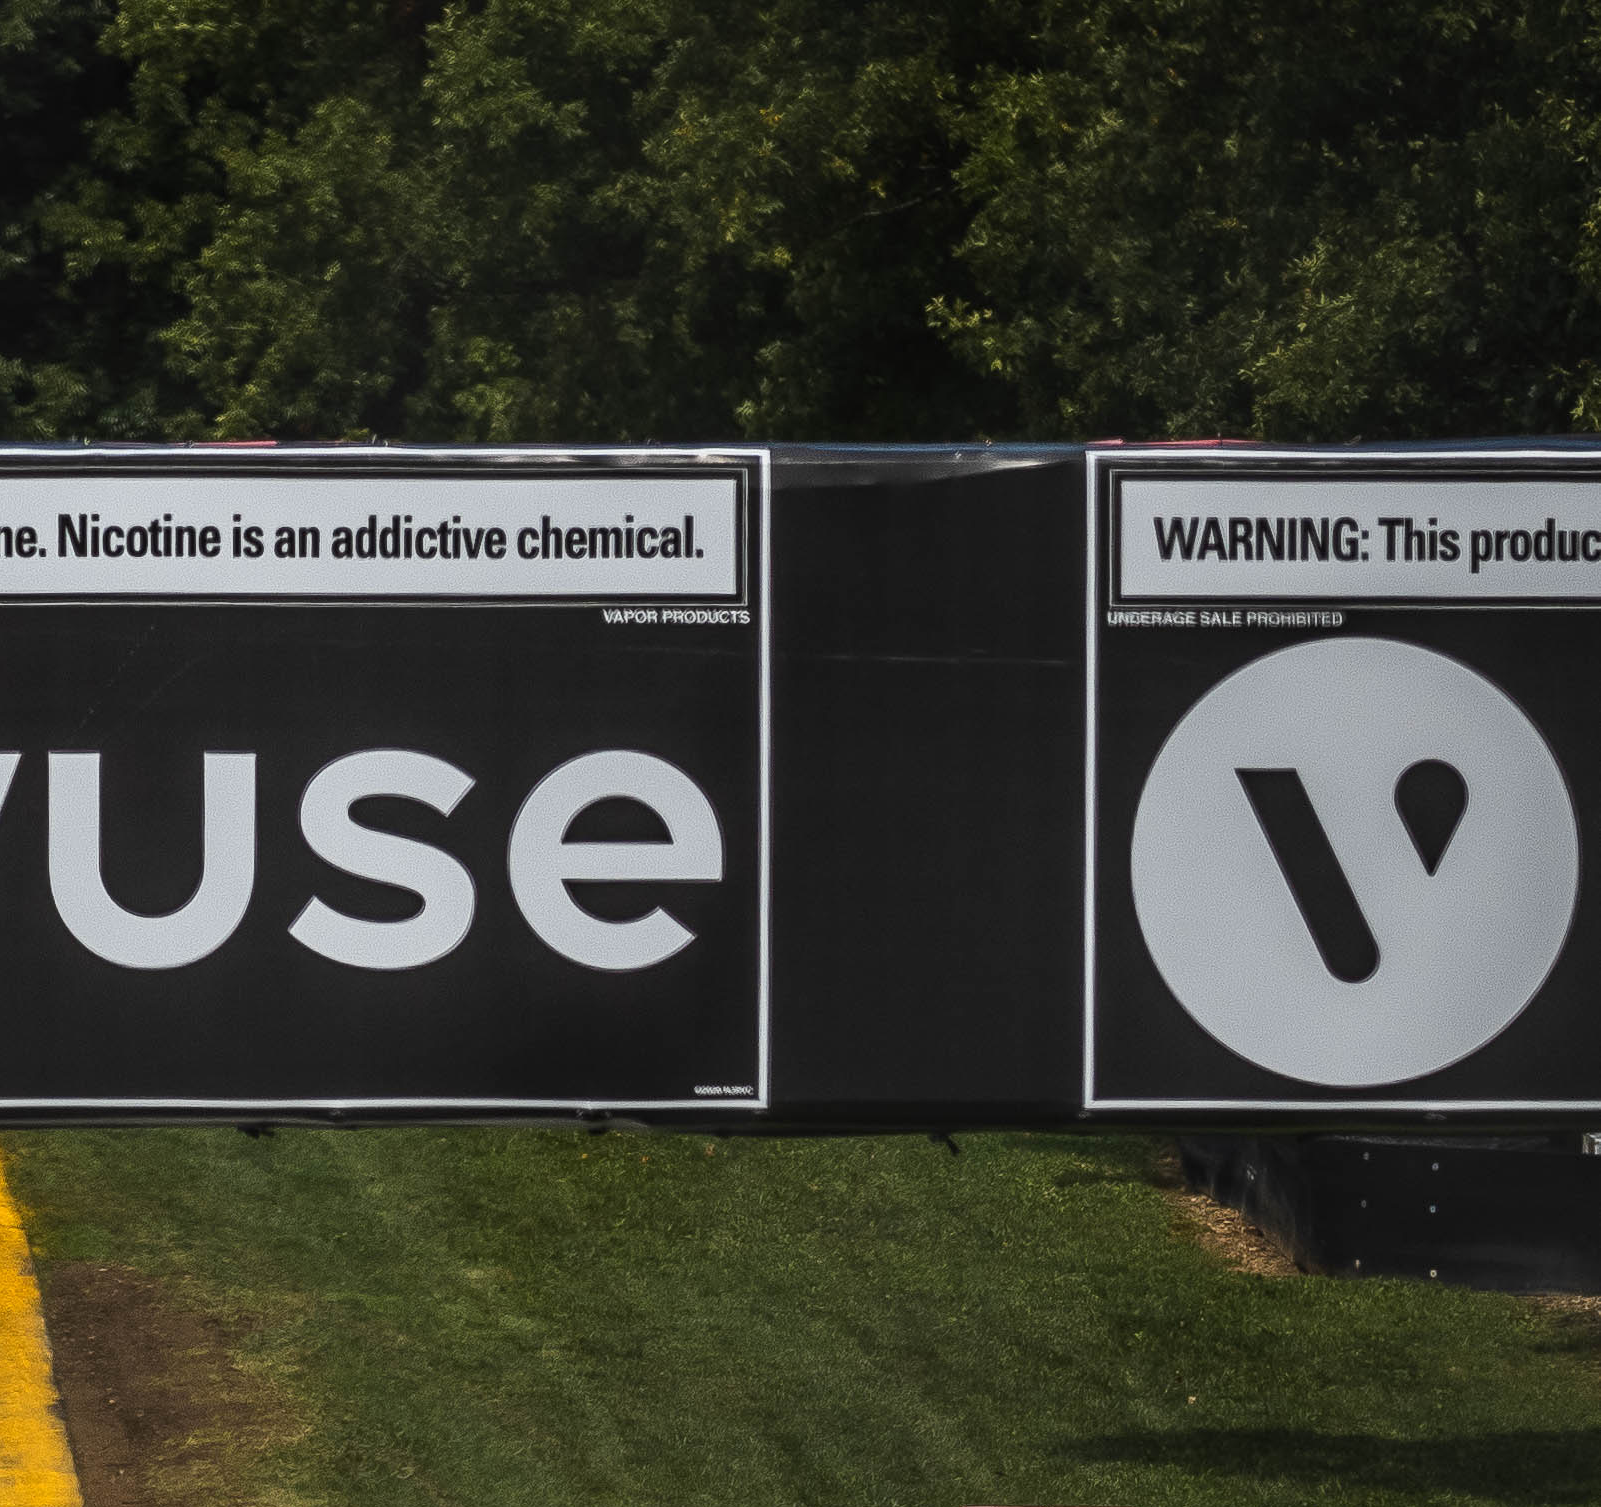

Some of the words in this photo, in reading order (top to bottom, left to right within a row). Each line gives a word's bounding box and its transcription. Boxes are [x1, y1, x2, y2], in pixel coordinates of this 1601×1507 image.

[59, 514, 220, 557] Nicotine
[233, 514, 264, 557] is
[275, 527, 319, 558] an
[332, 515, 506, 558] addictive
[518, 515, 703, 558] chemical.
[1154, 517, 1369, 561] WARNING:
[1379, 518, 1460, 561] This
[603, 608, 658, 624] VAPOR
[662, 609, 750, 624] PRODUCTS
[1107, 611, 1196, 626] UNDERAGE
[1200, 611, 1242, 626] SALE
[1247, 611, 1343, 627] PROHIBITED
